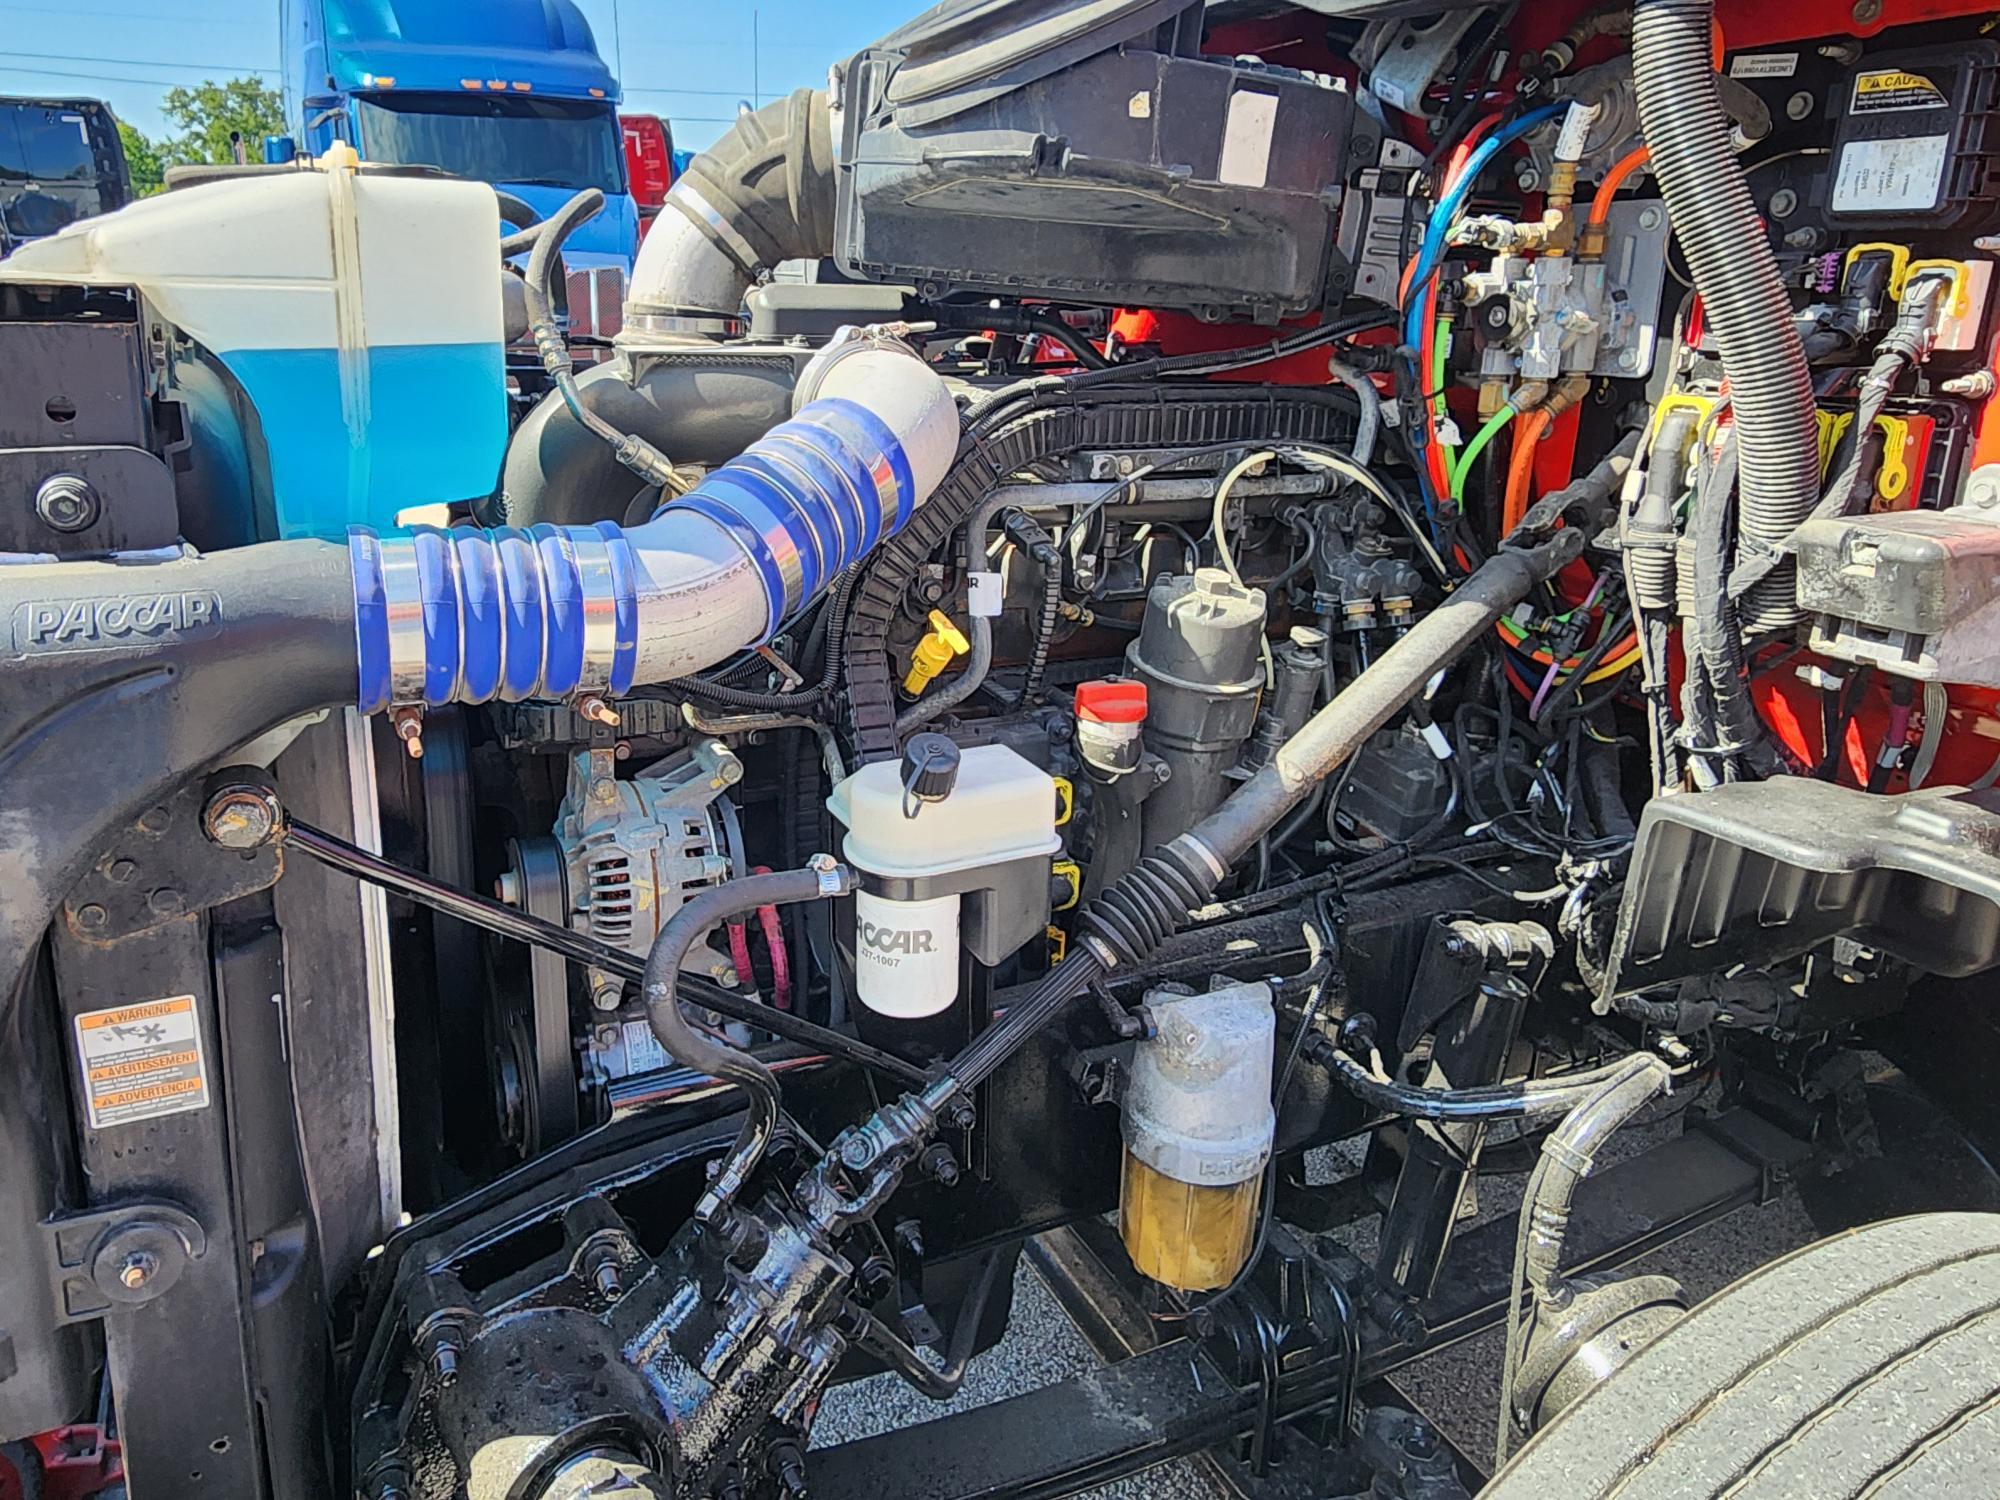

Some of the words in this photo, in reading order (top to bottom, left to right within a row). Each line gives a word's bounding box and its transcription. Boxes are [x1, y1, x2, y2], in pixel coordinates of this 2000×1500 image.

[28, 592, 214, 643] PACCAR
[116, 1003, 172, 1020] WARNING
[108, 1052, 196, 1075] AVERTISSEMENT
[117, 1080, 195, 1103] ADVERTENCIA
